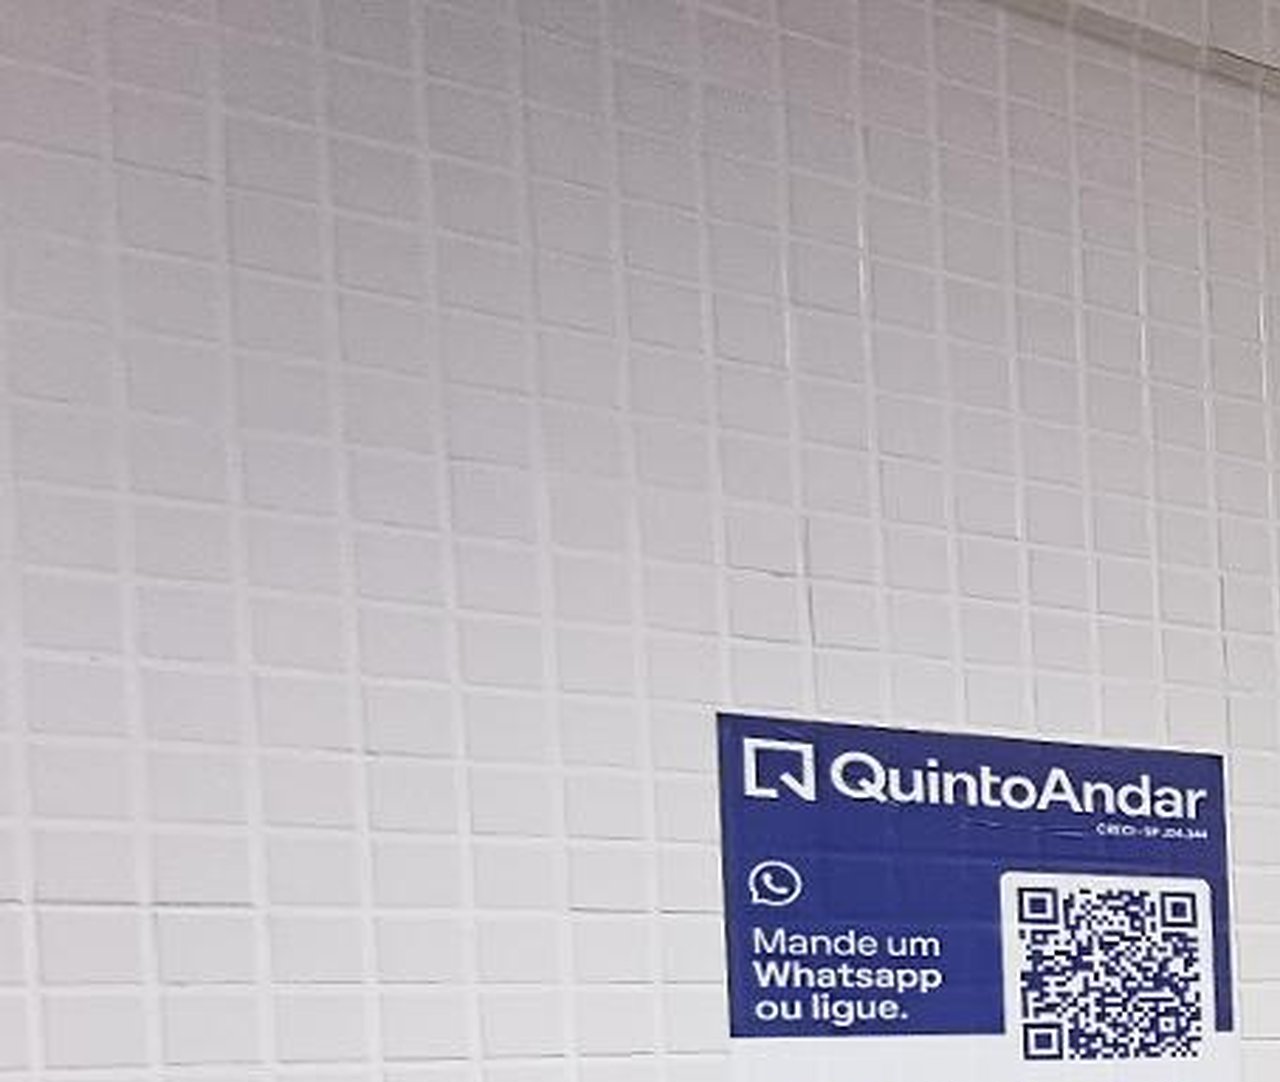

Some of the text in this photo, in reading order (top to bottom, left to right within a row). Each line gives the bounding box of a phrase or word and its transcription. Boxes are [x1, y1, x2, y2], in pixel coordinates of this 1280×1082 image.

[829, 750, 1208, 820] QuintoAndar
[752, 926, 941, 957] Mande um
[752, 959, 943, 993] Whatsapp
[755, 992, 909, 1028] ou ligue.
